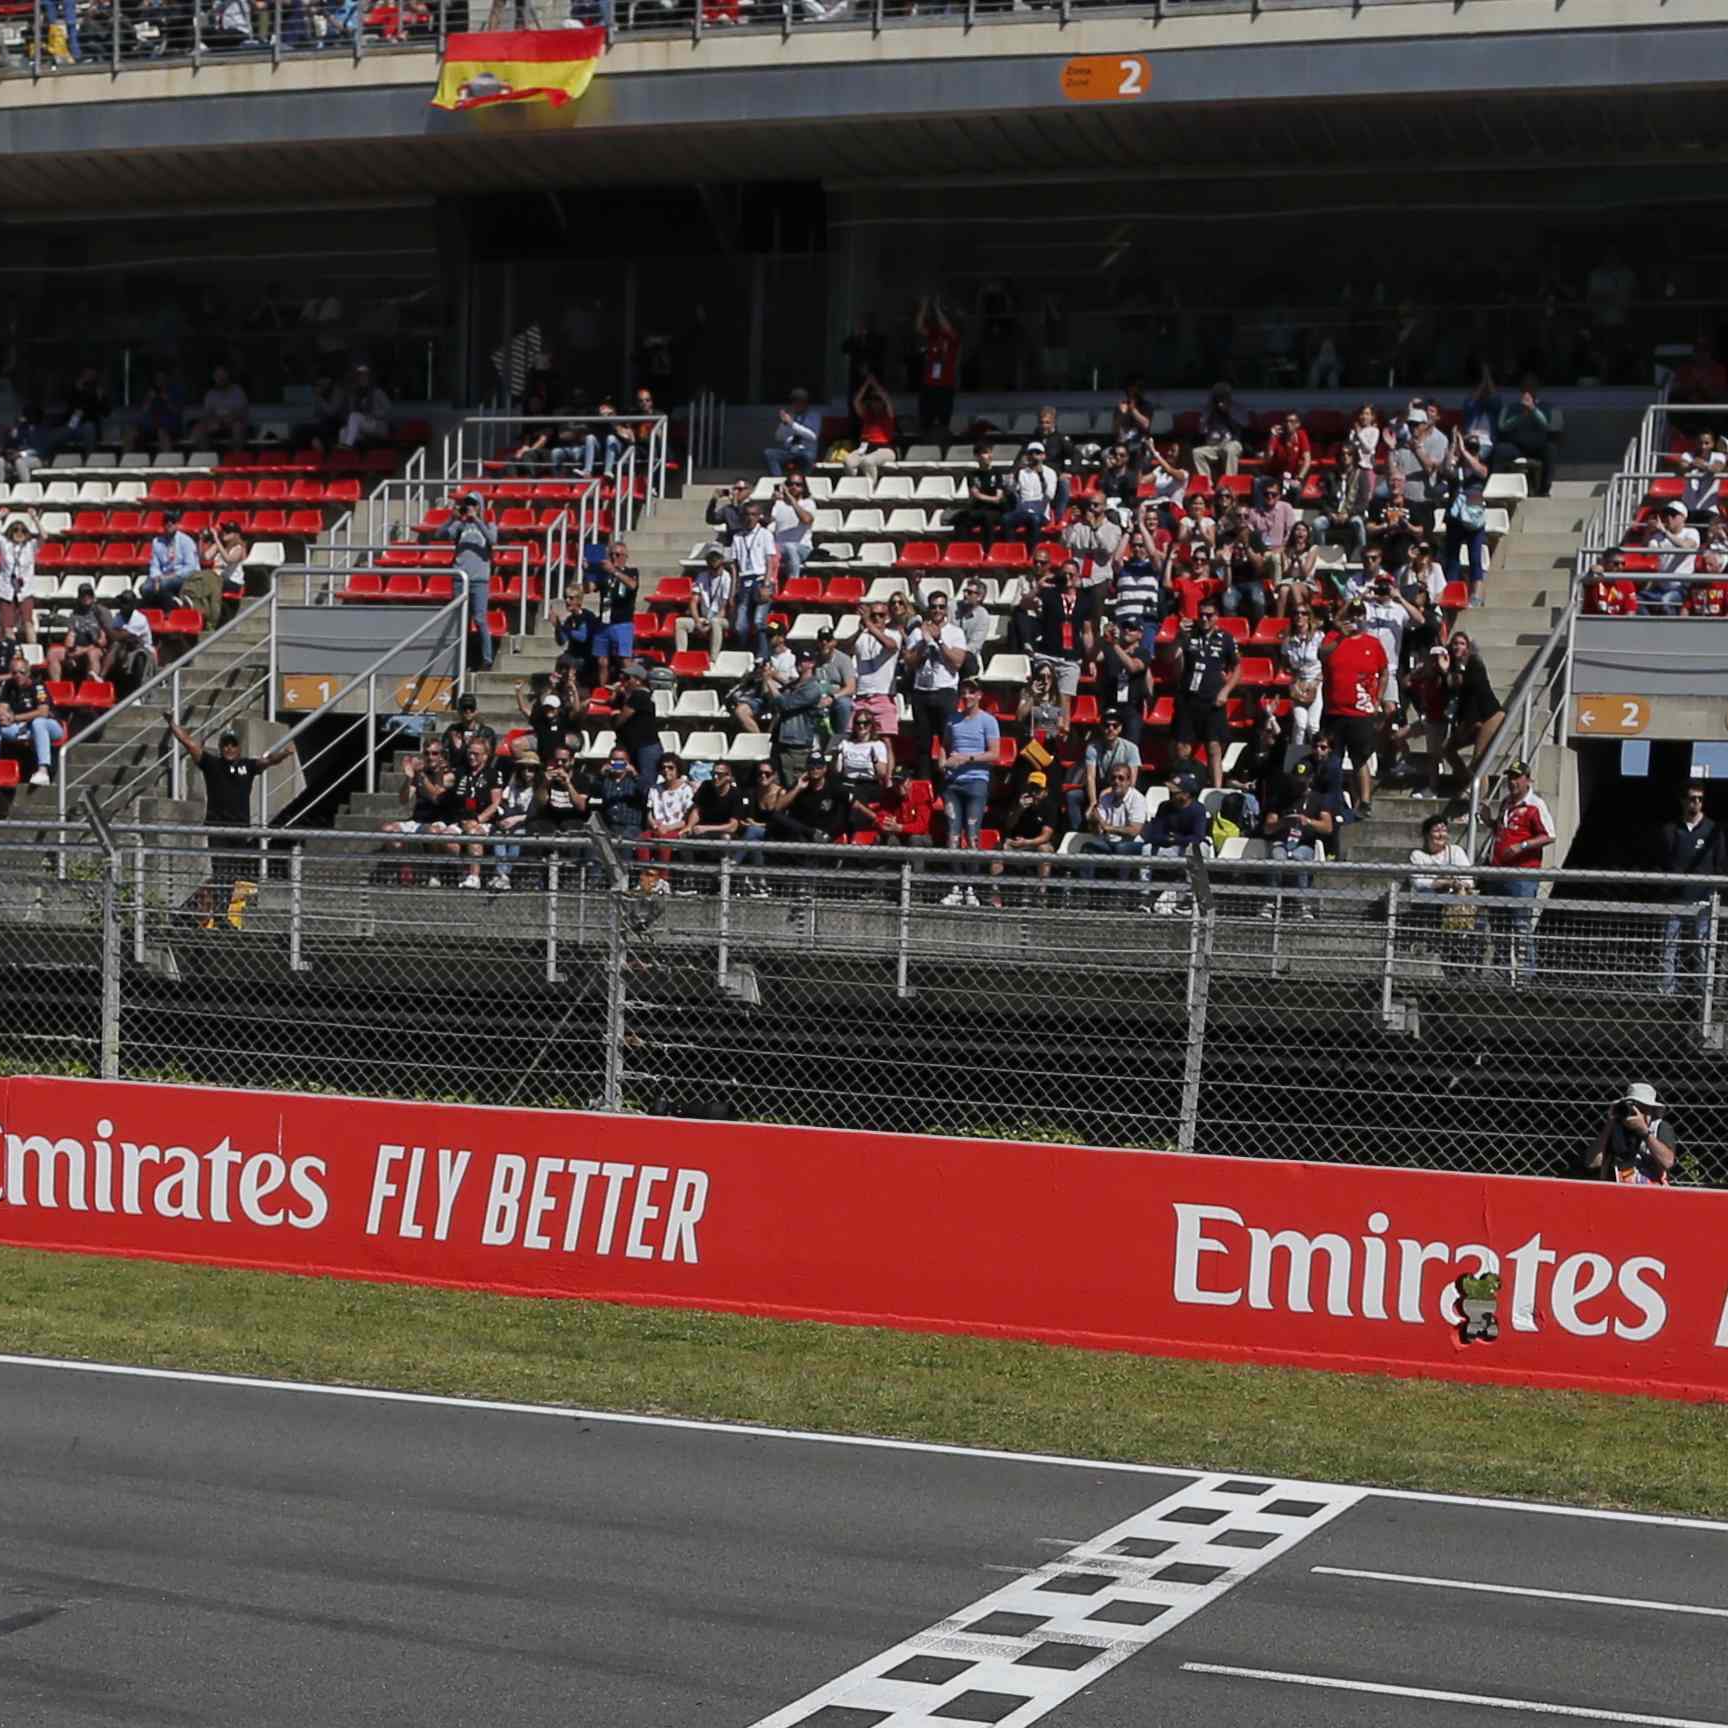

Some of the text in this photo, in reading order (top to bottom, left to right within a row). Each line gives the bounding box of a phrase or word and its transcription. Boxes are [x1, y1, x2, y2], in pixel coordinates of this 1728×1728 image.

[1118, 60, 1142, 94] 2
[319, 682, 330, 703] 1
[1621, 703, 1639, 727] 2
[365, 1144, 471, 1241] FLY
[480, 1154, 710, 1264] BETTER
